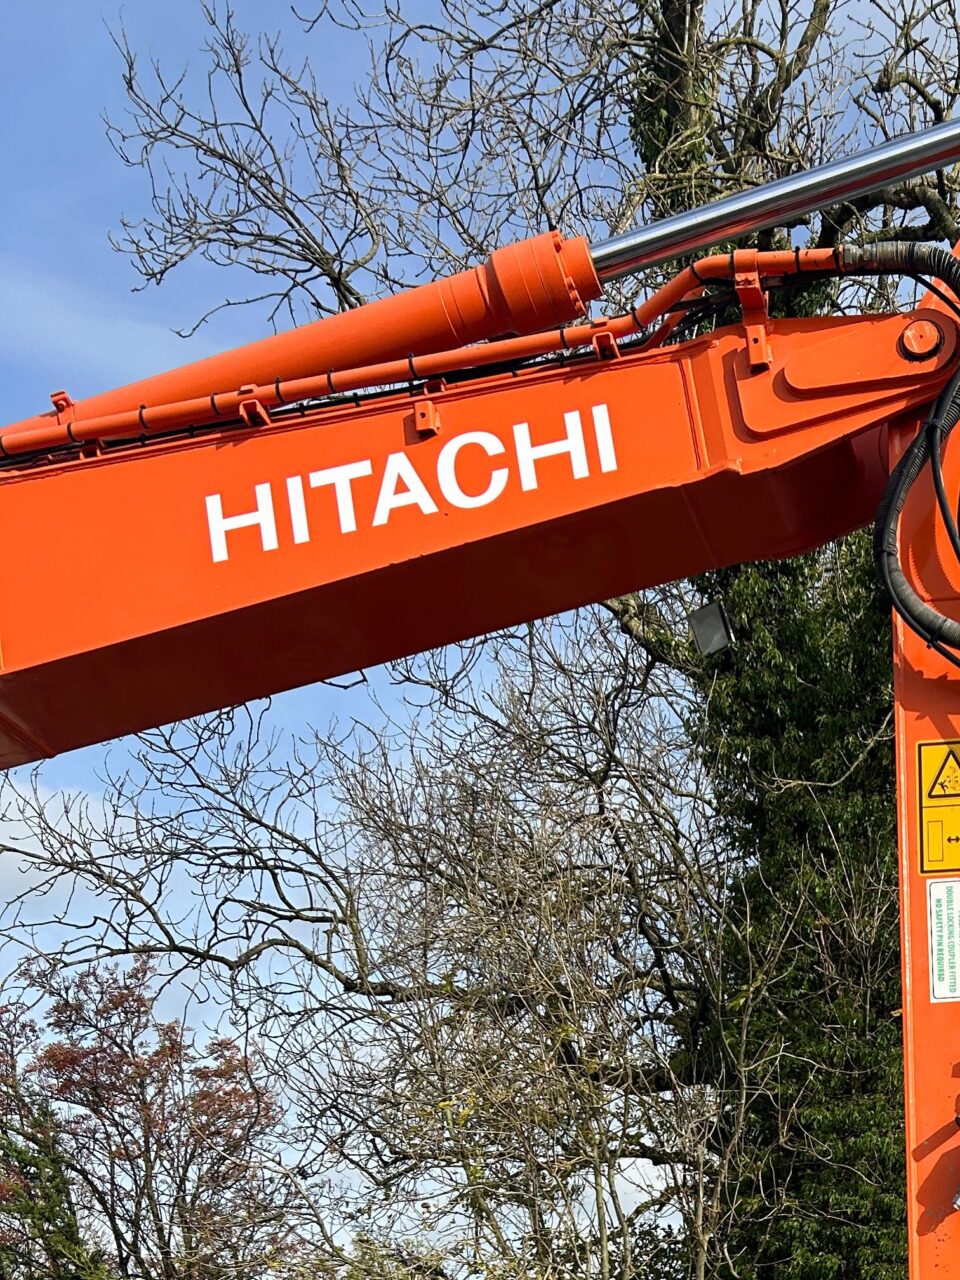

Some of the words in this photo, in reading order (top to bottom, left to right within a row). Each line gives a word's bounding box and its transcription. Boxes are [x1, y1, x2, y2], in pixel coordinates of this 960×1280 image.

[204, 403, 618, 563] HITACHI
[935, 898, 942, 909] NO
[946, 886, 954, 911] DOUBLE
[935, 909, 943, 934] SAFETY
[946, 912, 955, 940] LOCKING
[936, 934, 944, 947] PIN
[948, 940, 956, 970] COUPLER
[949, 971, 957, 993] FITTED
